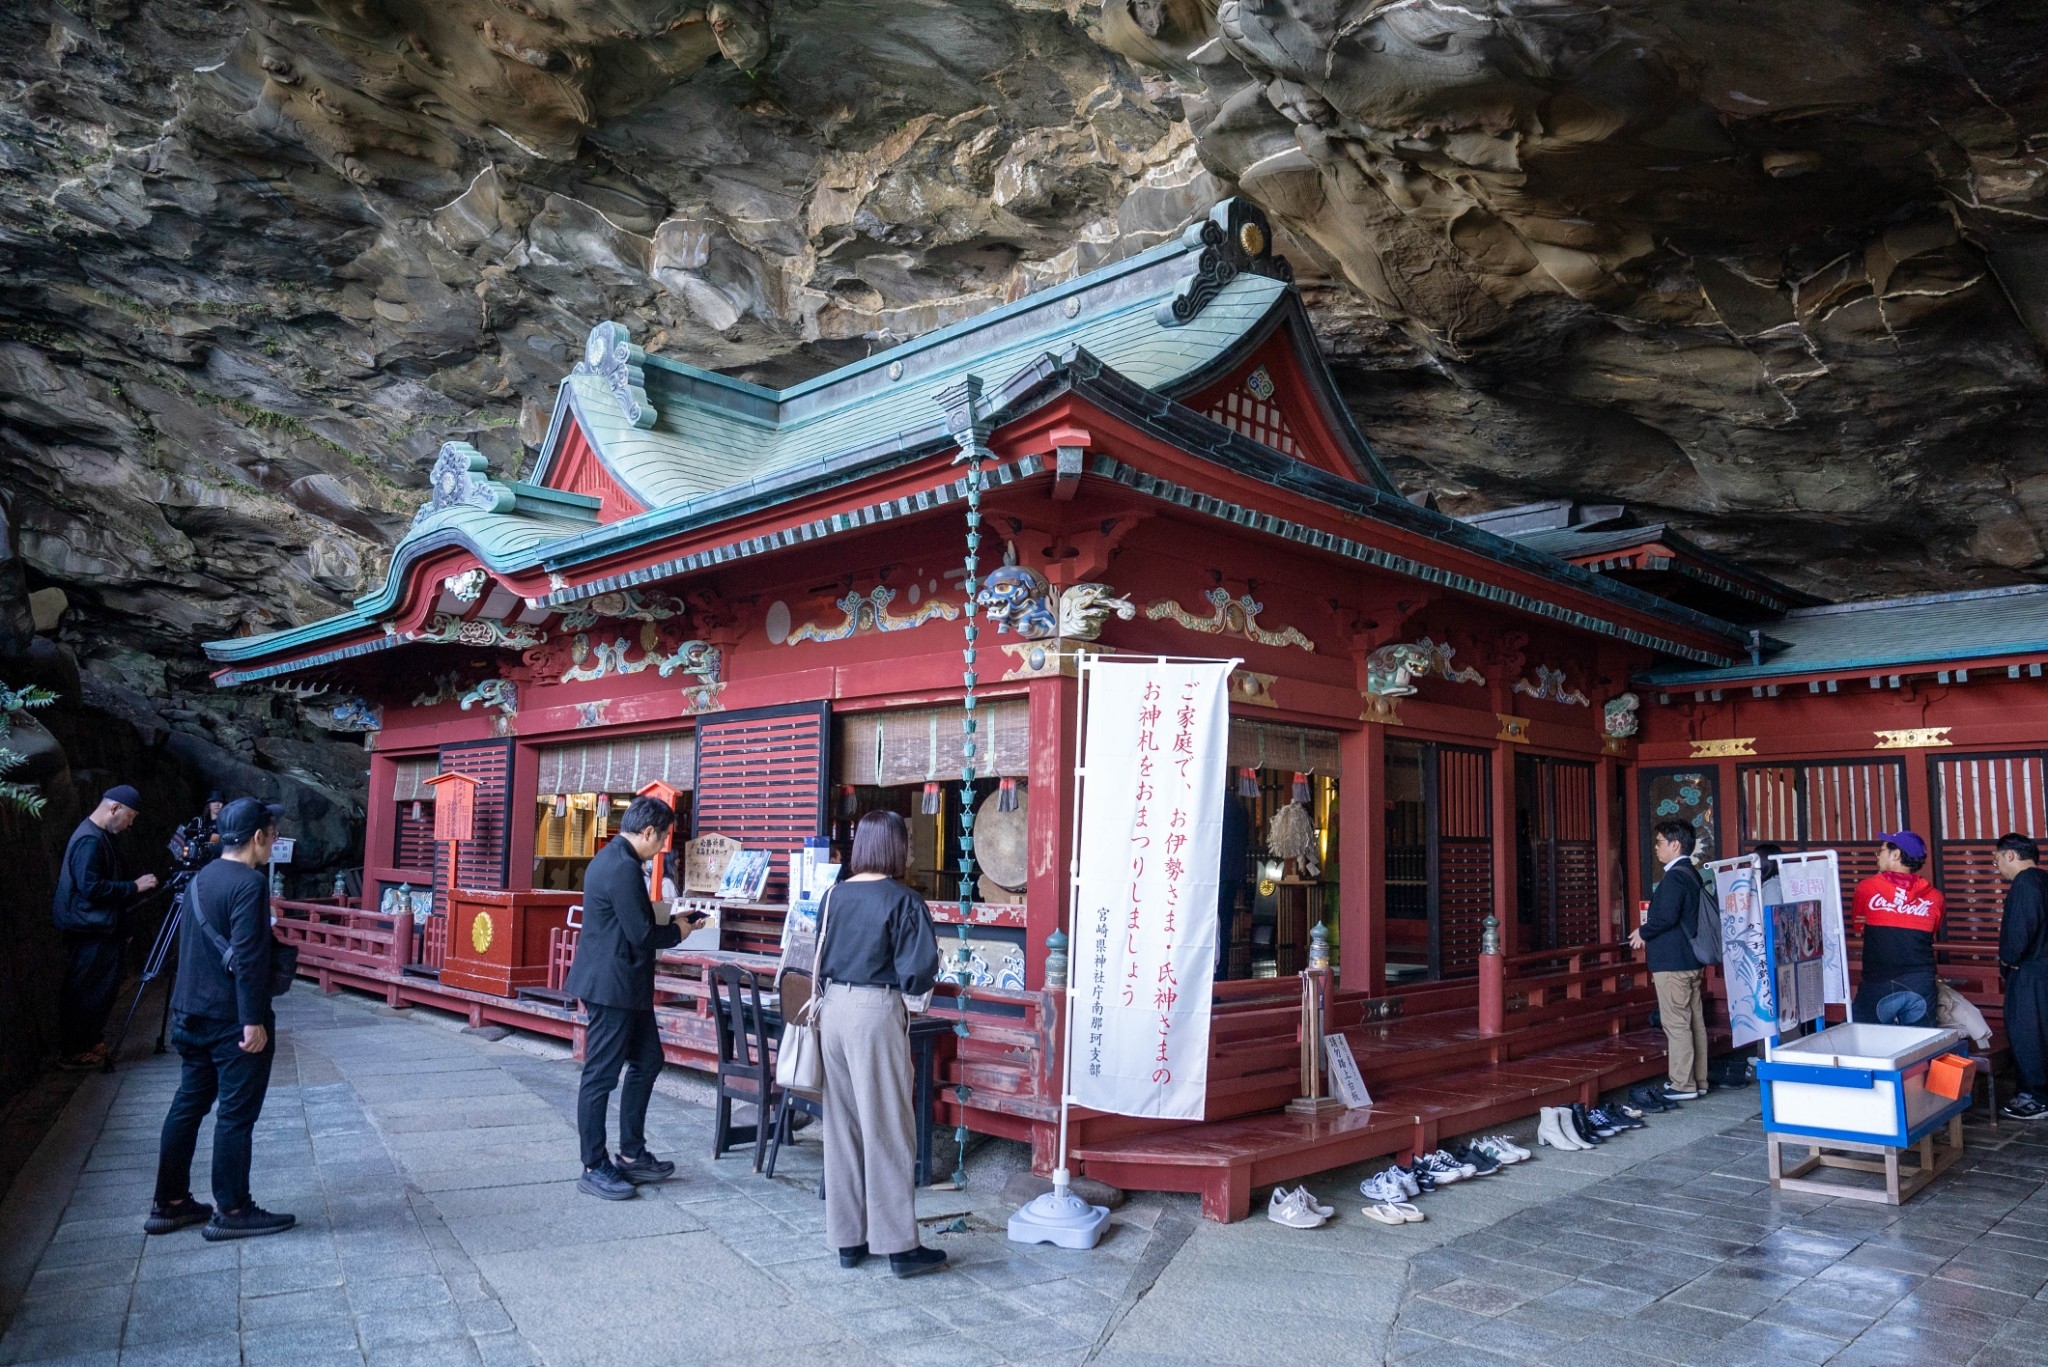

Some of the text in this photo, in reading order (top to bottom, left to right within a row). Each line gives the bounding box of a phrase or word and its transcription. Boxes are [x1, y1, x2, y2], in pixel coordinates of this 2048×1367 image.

[1089, 906, 1110, 1078] 宮崎県神社庁南那珂支部
[1122, 681, 1162, 1007] お神札をおまつりしましょう
[1152, 681, 1200, 1085] ご家庭で、お伊勢さま・氏神さまの
